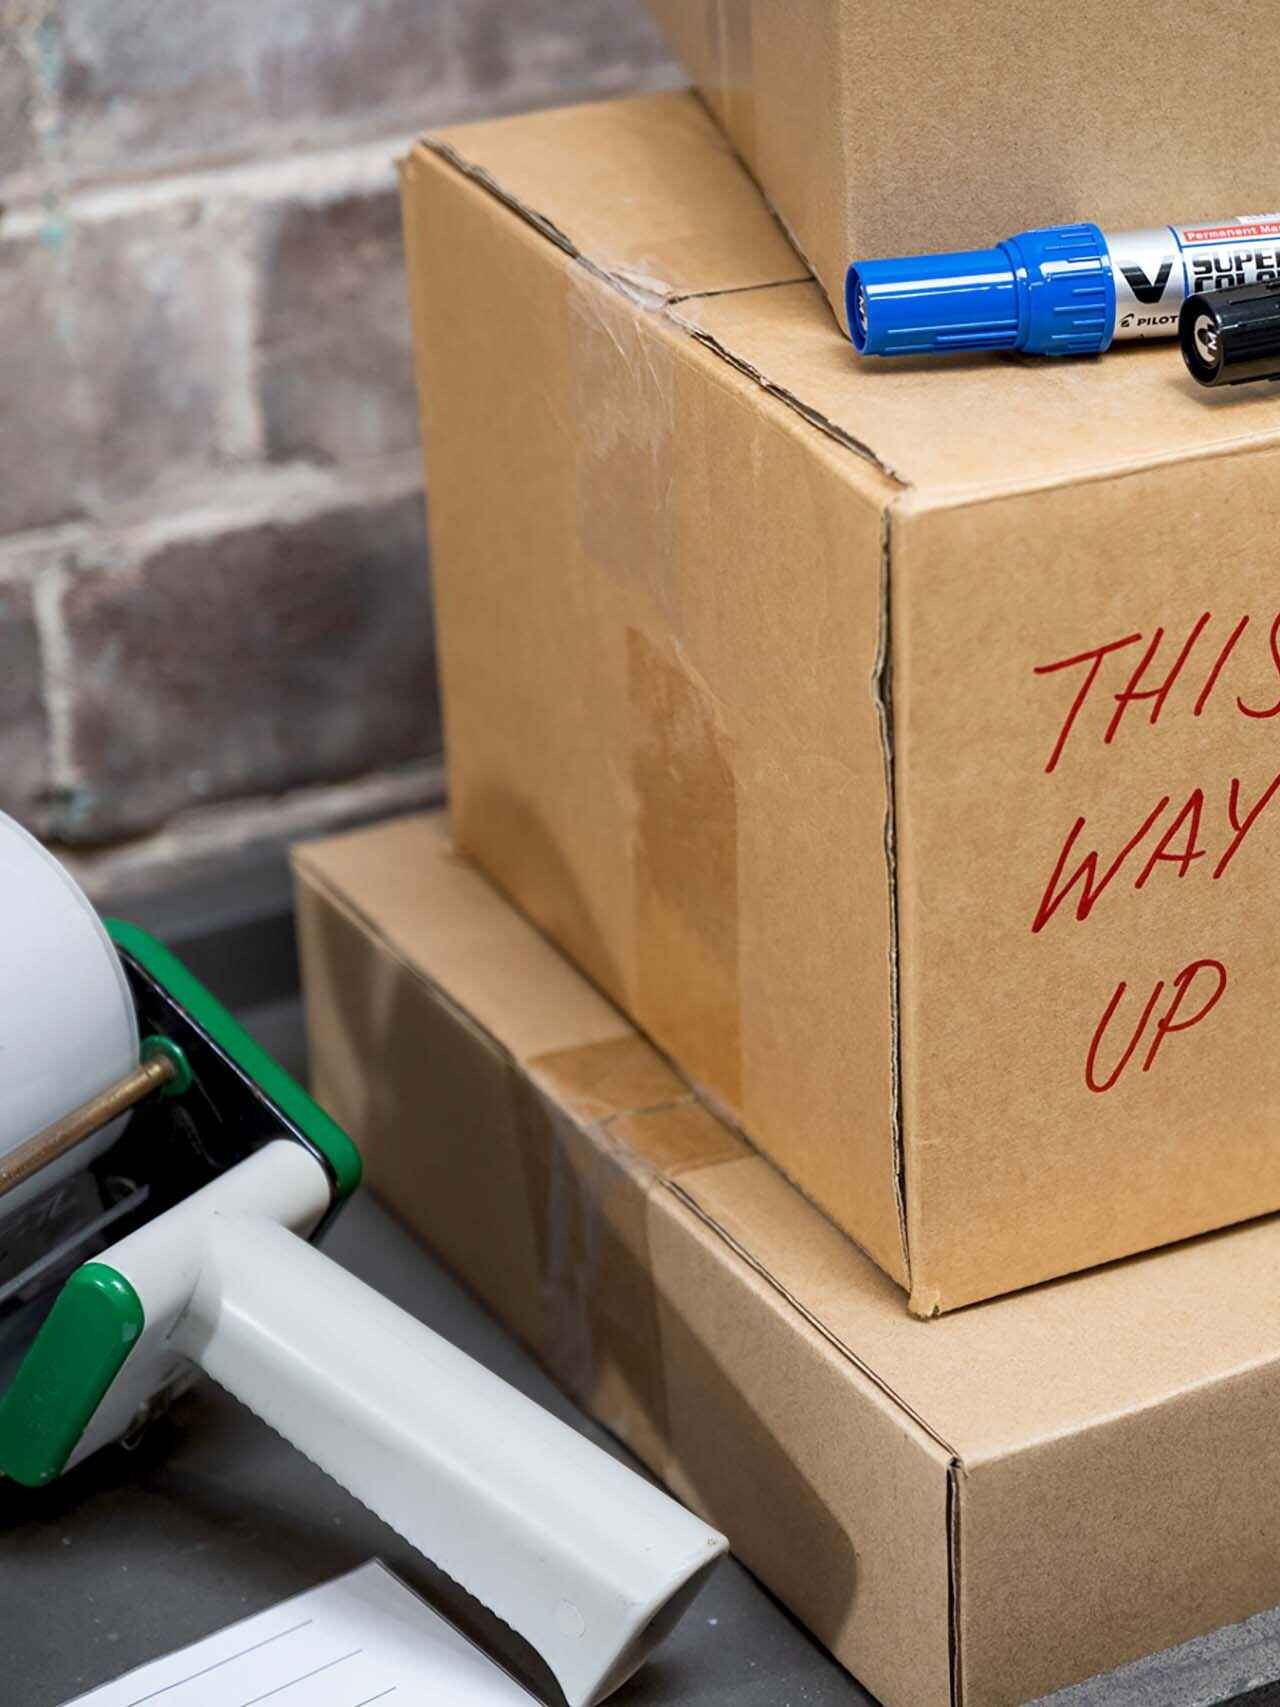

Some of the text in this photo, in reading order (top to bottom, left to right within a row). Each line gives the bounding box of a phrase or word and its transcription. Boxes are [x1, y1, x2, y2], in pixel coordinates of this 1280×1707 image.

[1187, 225, 1257, 241] Permanent
[1118, 257, 1174, 305] V
[1136, 315, 1179, 327] PILOT
[1085, 958, 1228, 1094] UP
